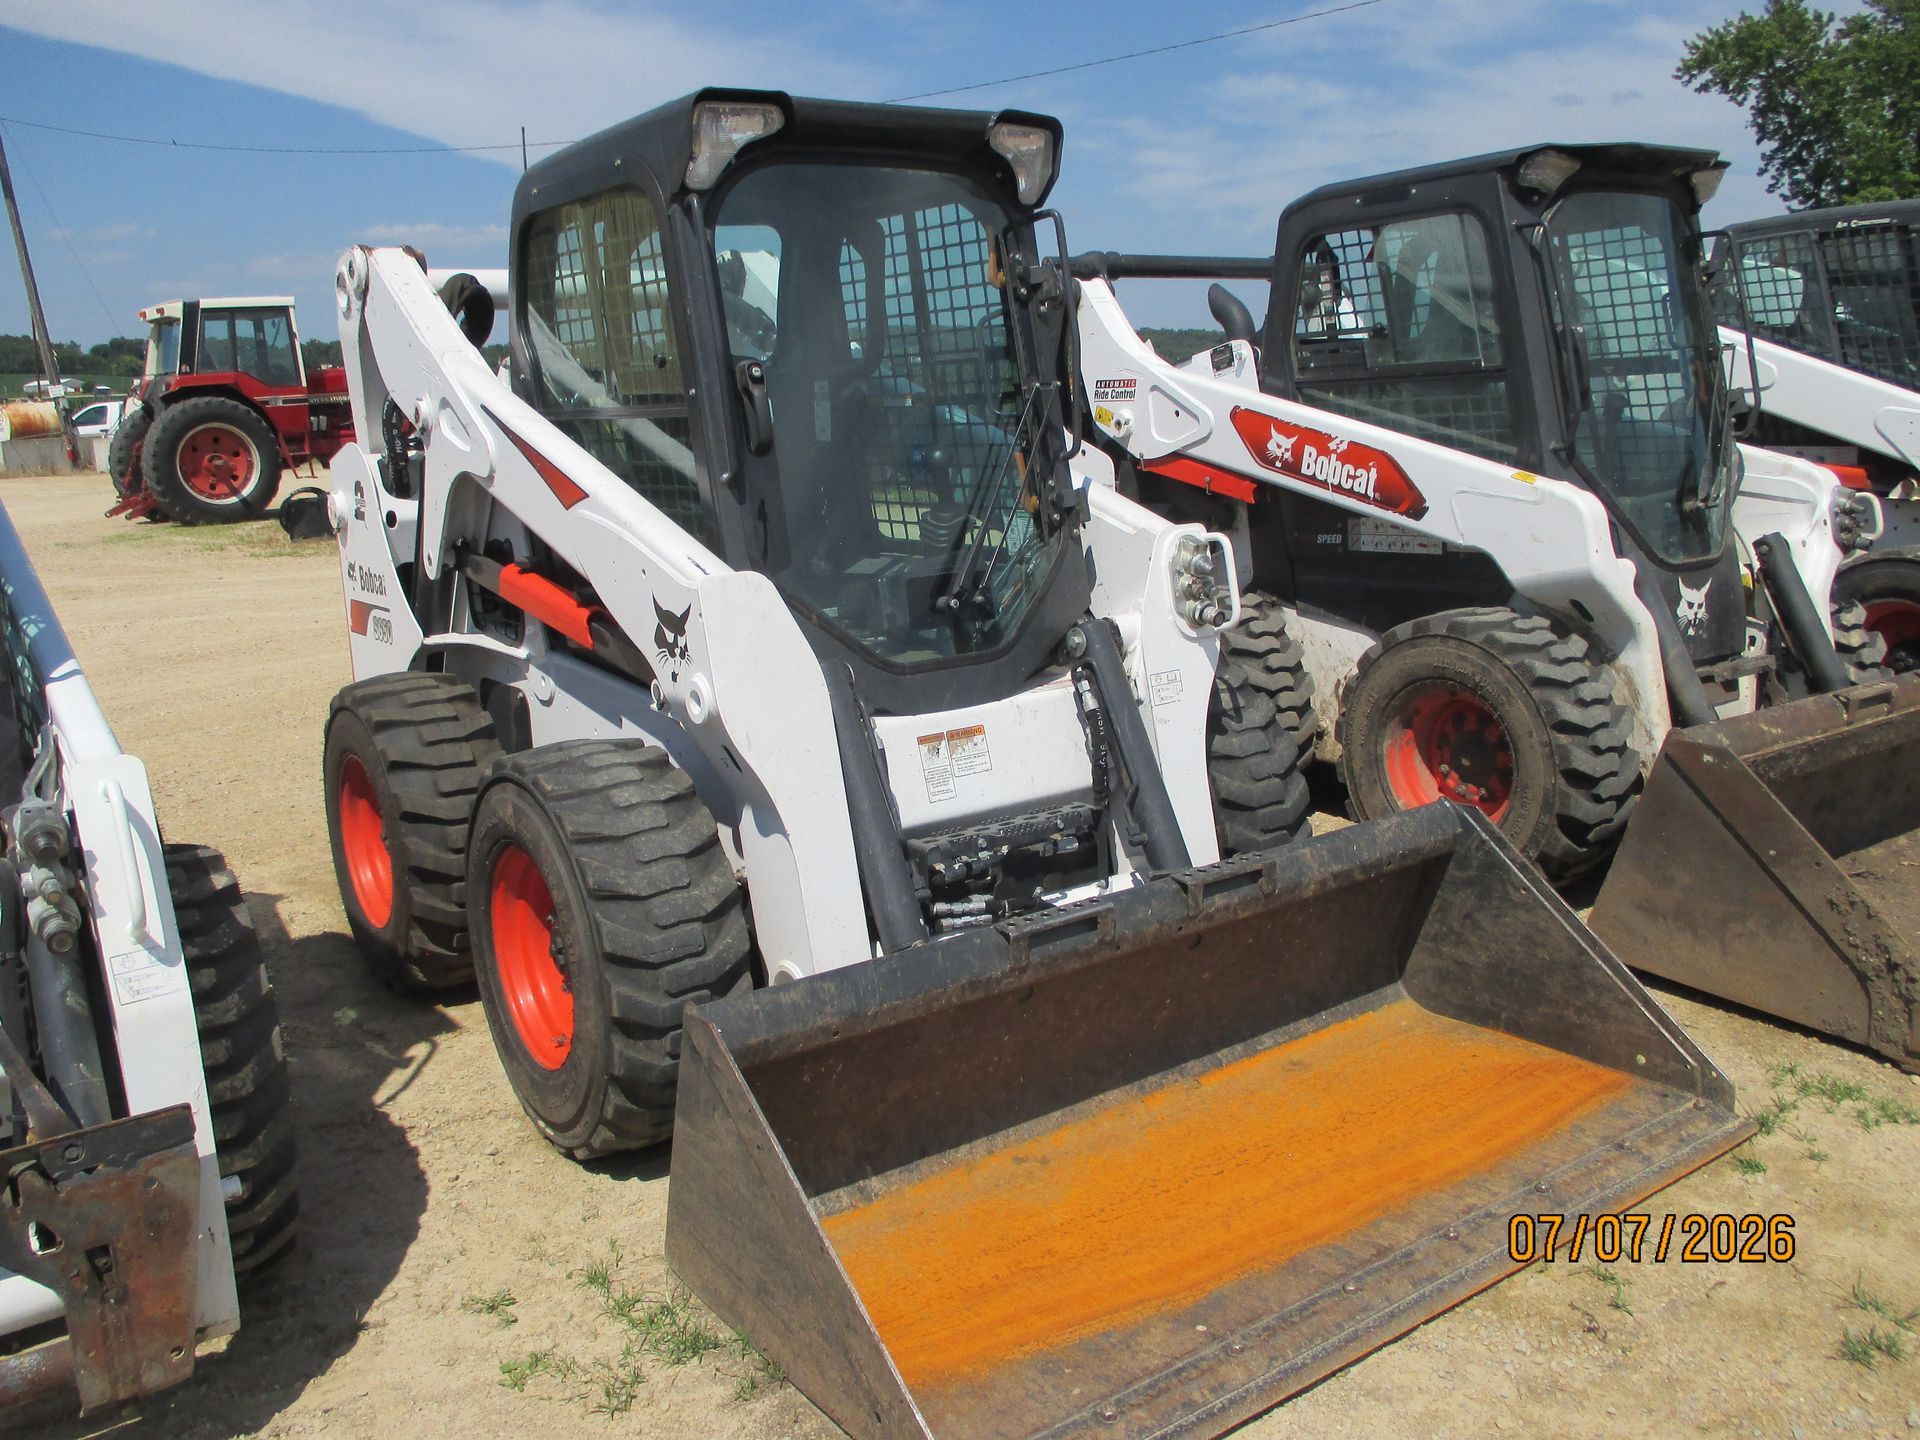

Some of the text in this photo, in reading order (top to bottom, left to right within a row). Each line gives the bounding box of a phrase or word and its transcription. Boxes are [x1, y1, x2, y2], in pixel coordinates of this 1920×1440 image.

[1096, 380, 1136, 388] AUTOMATIC
[1094, 389, 1136, 400] Ride Control
[1301, 444, 1377, 499] Bobcat
[1316, 534, 1342, 544] SPEED
[359, 565, 387, 597] Bobcat
